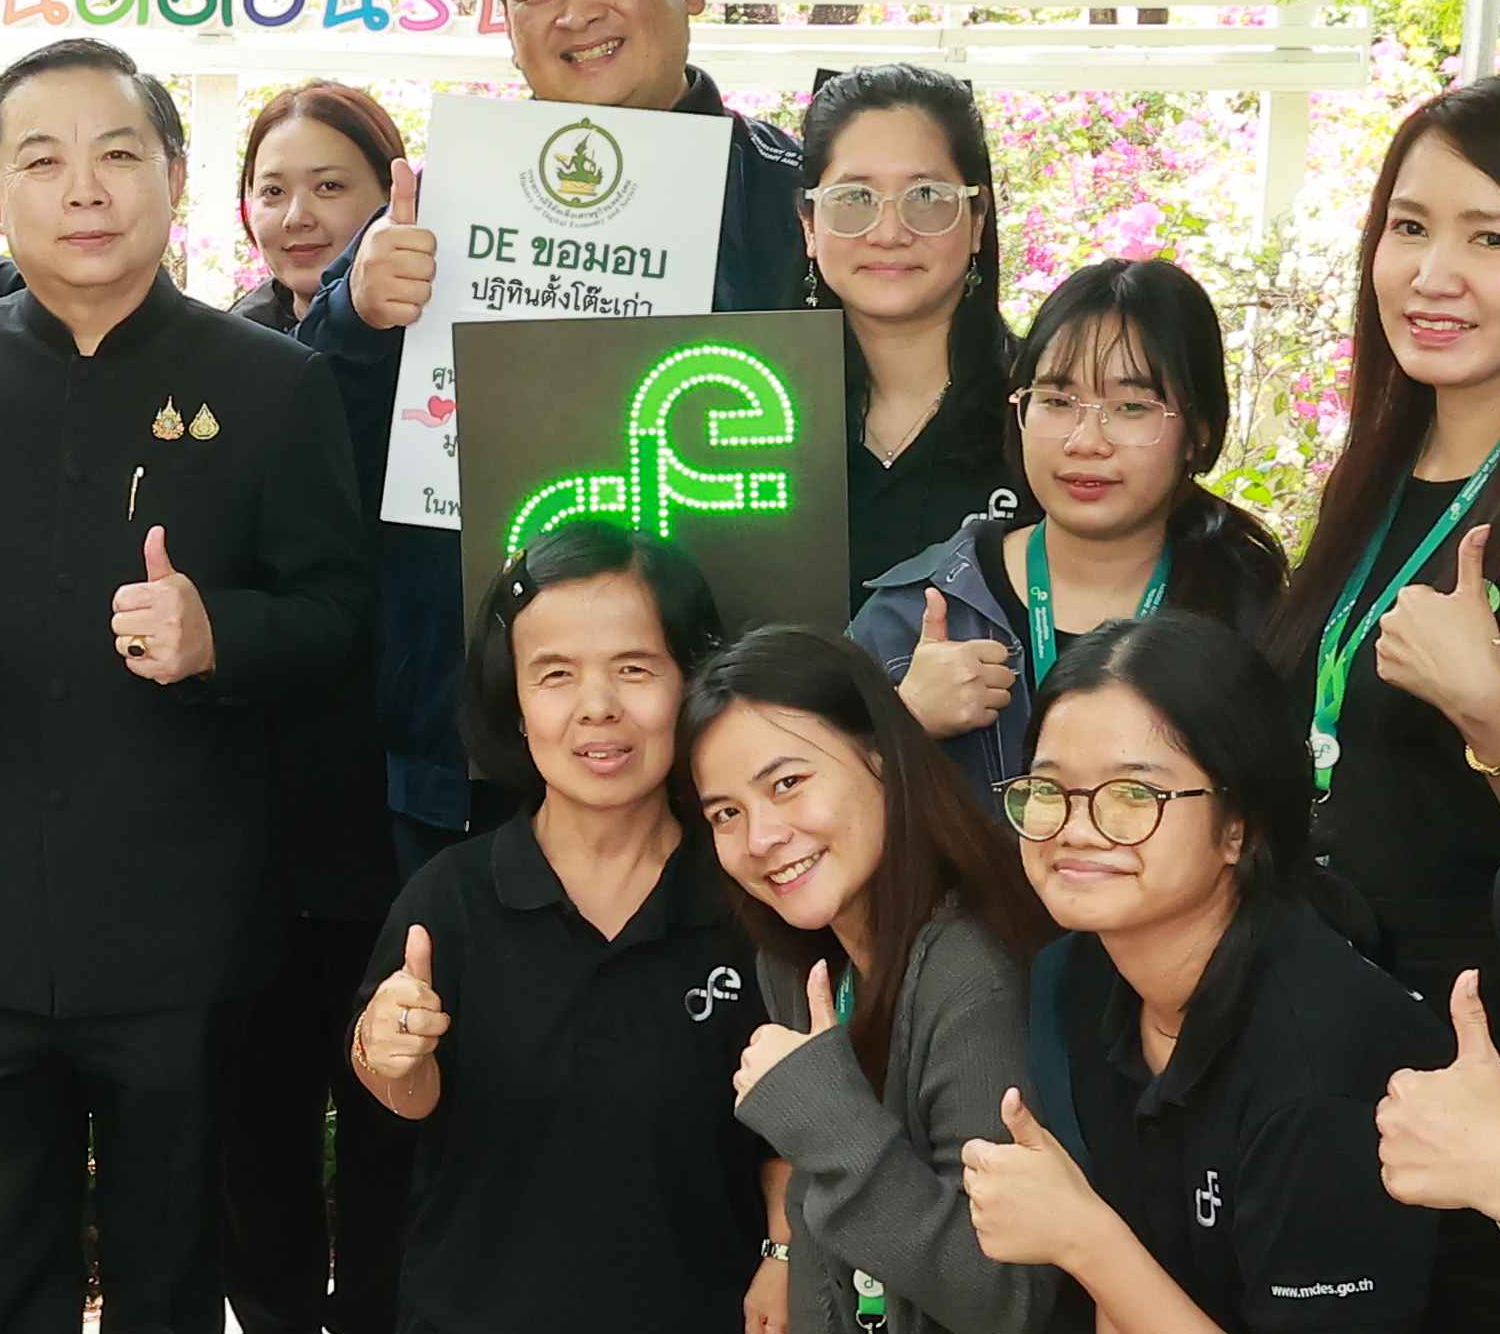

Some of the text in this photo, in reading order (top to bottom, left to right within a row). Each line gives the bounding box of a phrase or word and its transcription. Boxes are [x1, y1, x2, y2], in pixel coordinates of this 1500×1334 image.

[467, 223, 668, 280] DE ขอมอบ
[1271, 1277, 1374, 1299] www.mdes.go.th
